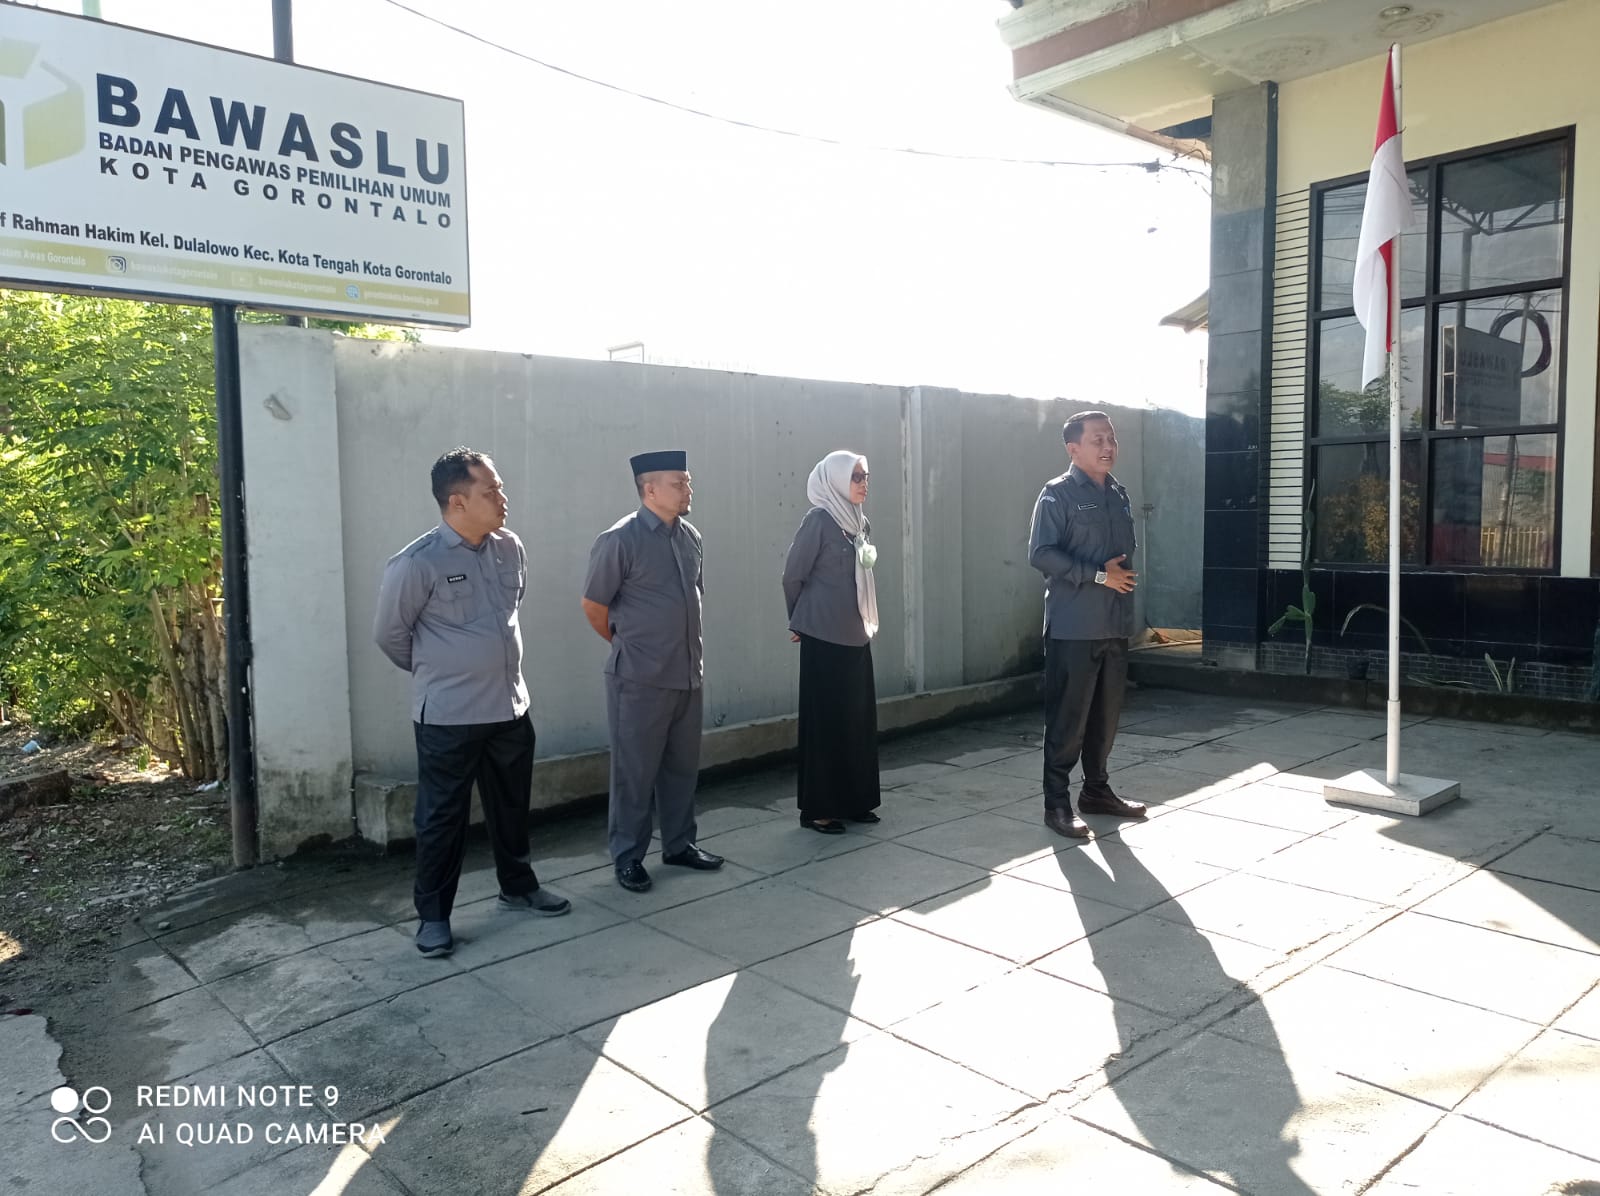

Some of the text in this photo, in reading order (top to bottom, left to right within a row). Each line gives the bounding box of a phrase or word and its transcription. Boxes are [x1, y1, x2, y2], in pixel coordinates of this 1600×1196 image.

[96, 73, 450, 186] BAWASLU
[99, 132, 451, 209] BADAN PENGAWAS PEMILIHAN UMUM
[100, 157, 451, 229] KOTA GORONTALO
[12, 213, 80, 237] Rahman
[85, 223, 135, 244] Hakim
[140, 230, 169, 249] Kel.
[173, 235, 240, 258] Dulalowo
[243, 243, 275, 263] Kec.
[278, 248, 310, 267] Kota
[312, 253, 360, 275] Tengah
[363, 260, 392, 278] Kota
[394, 265, 453, 286] Gorontalo
